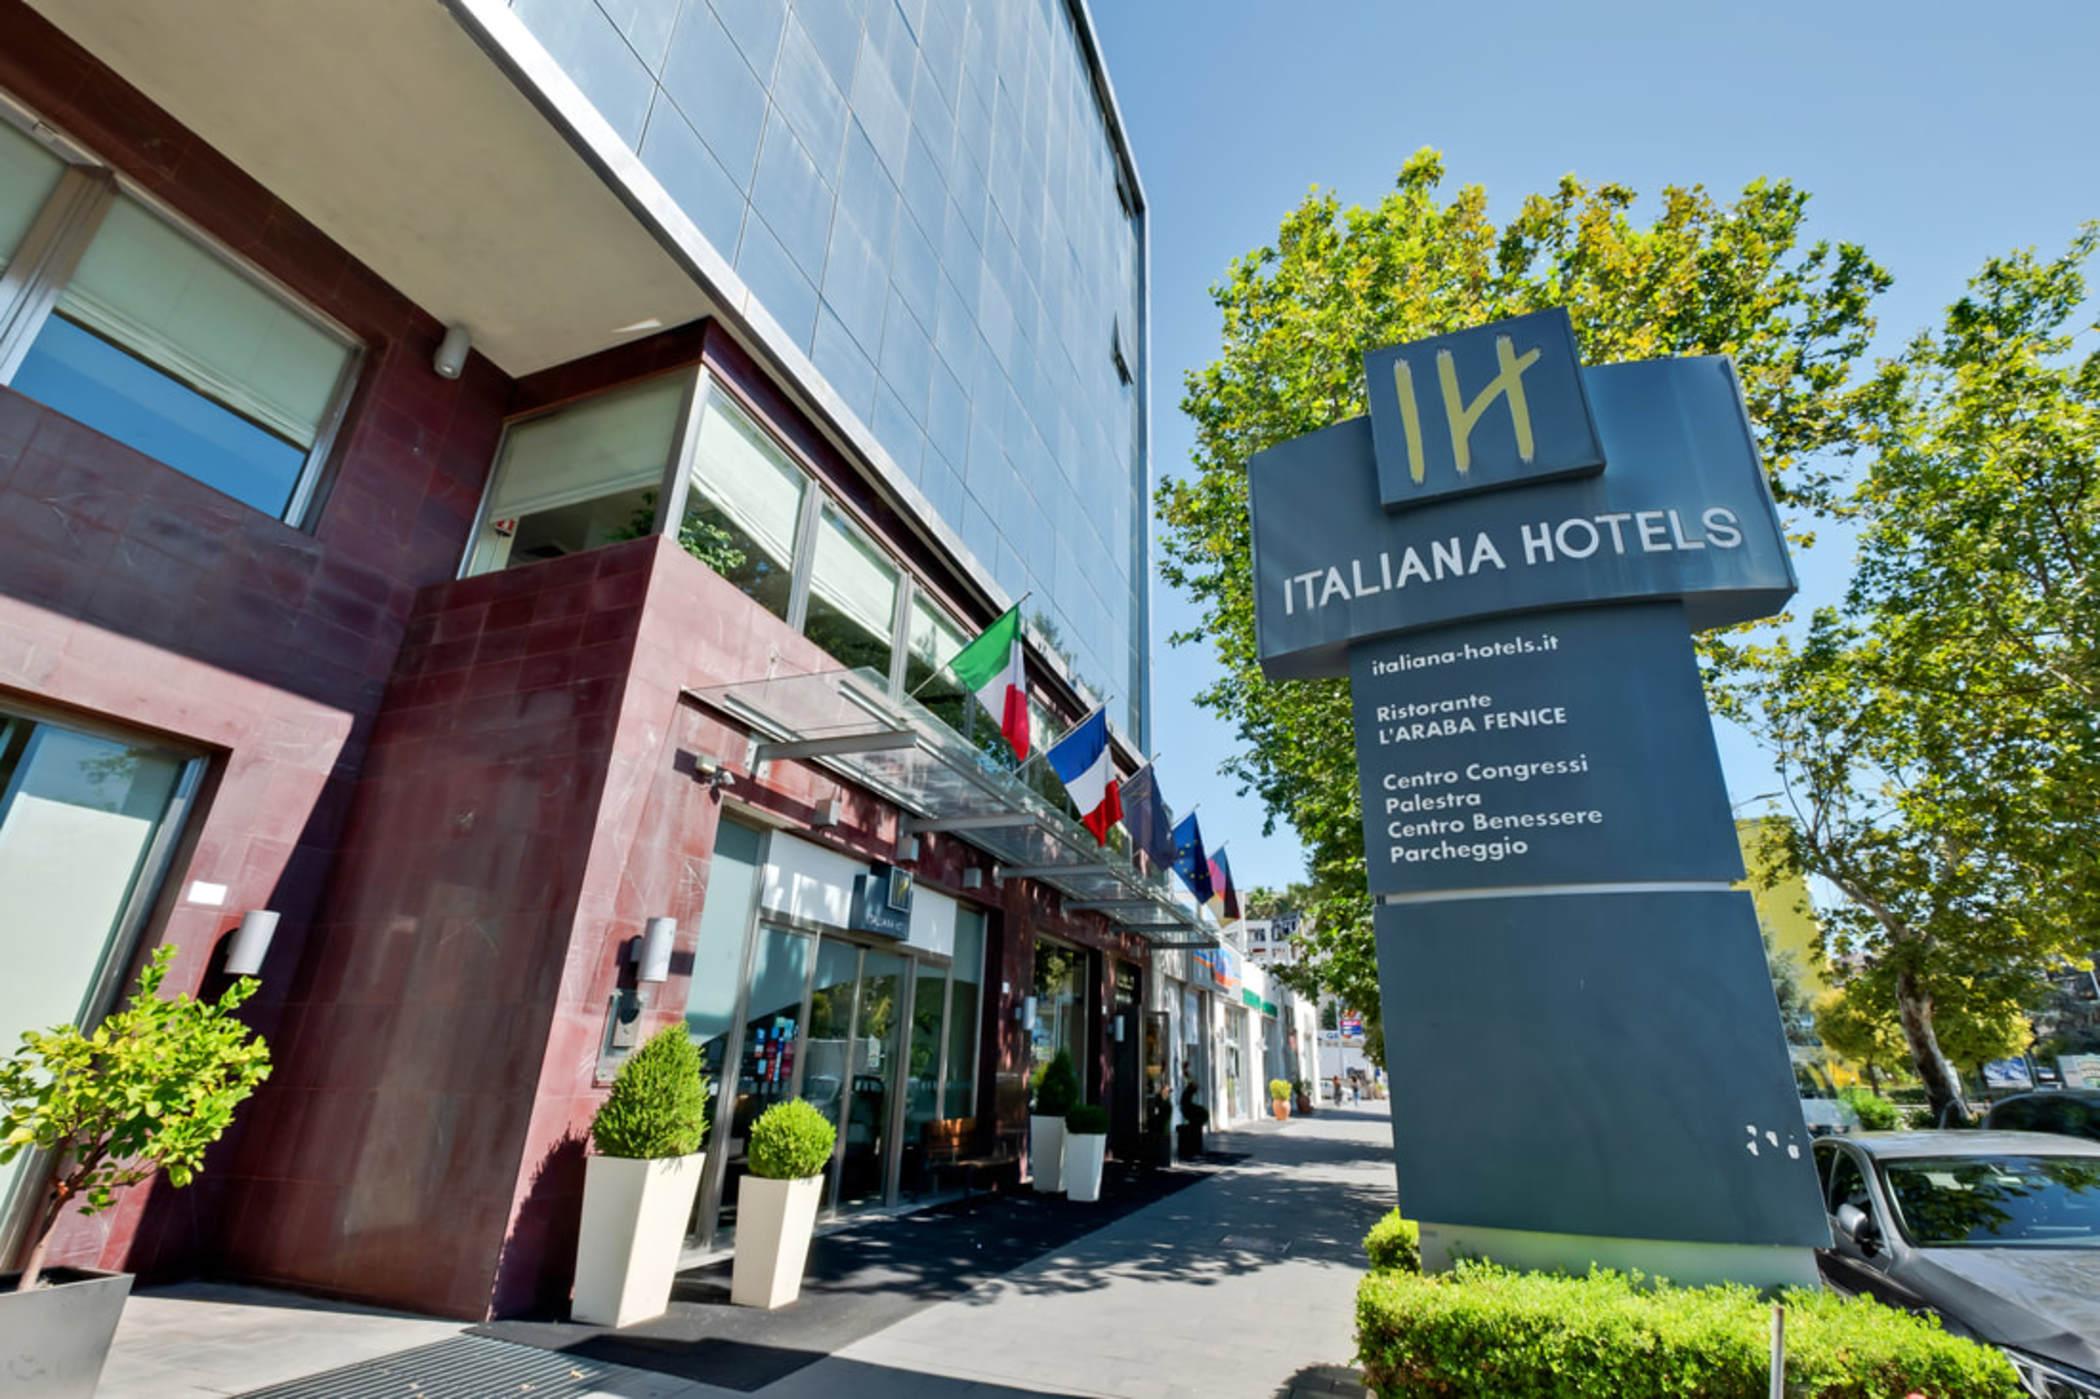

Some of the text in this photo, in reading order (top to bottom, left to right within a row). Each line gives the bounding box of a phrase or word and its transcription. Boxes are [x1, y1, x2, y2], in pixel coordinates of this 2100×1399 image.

[1284, 506, 1742, 615] ITALIANA HOTELS
[1371, 633, 1559, 676] italiana-hotels.it
[1376, 694, 1492, 722] Ristorante
[1379, 707, 1567, 744] L'ARABA FENICE
[1383, 754, 1588, 790] Centro Congressi
[1386, 792, 1481, 814] Palestra
[1388, 809, 1603, 838] Centro Benessere
[1390, 836, 1528, 863] Parcheggio
